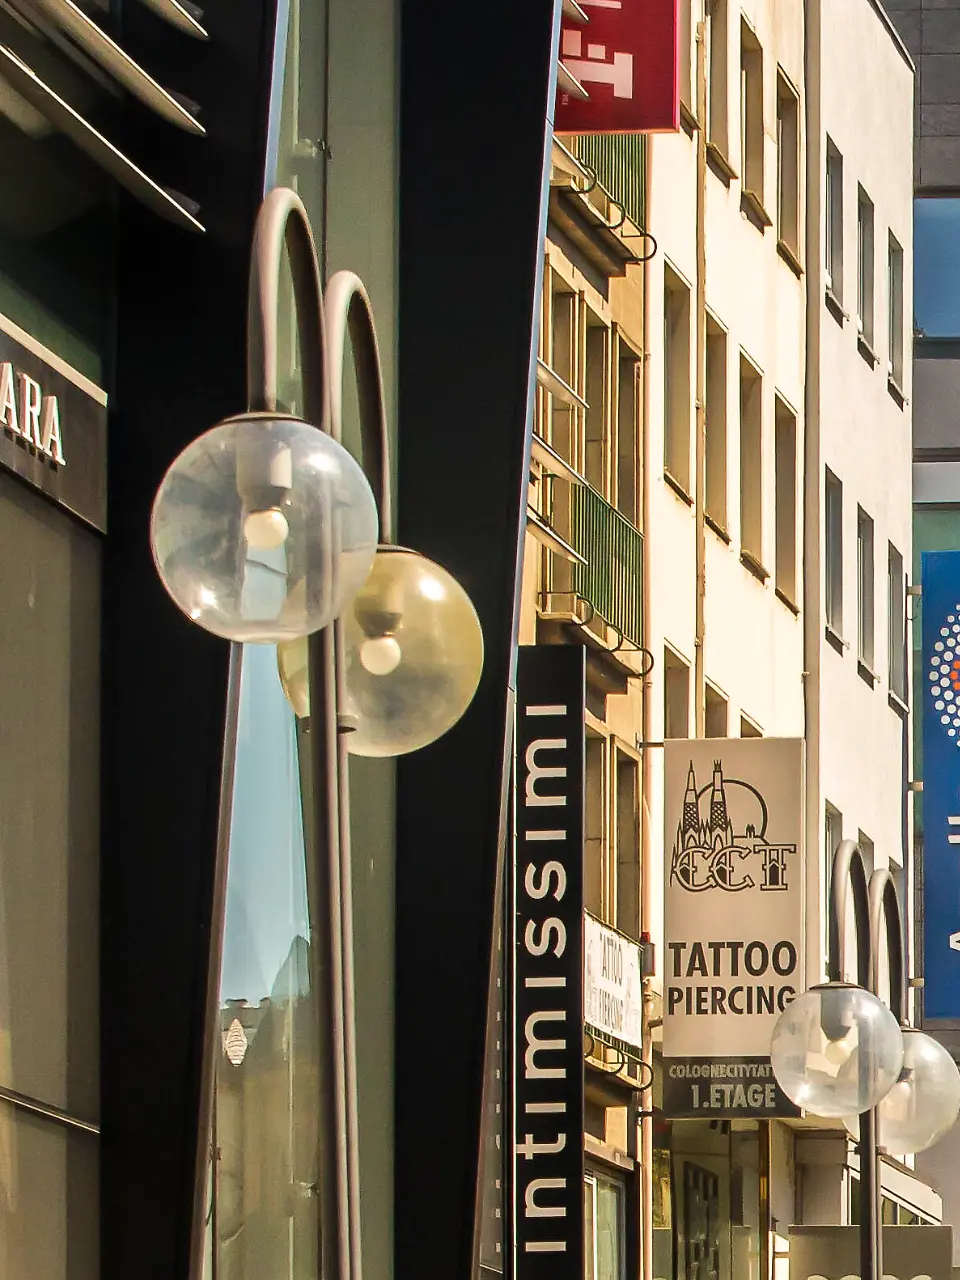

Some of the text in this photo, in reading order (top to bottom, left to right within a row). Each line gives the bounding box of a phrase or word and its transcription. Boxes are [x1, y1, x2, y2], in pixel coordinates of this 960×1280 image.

[0, 362, 66, 466] ARA
[668, 941, 797, 977] TATTOO
[668, 986, 796, 1015] PIERCING
